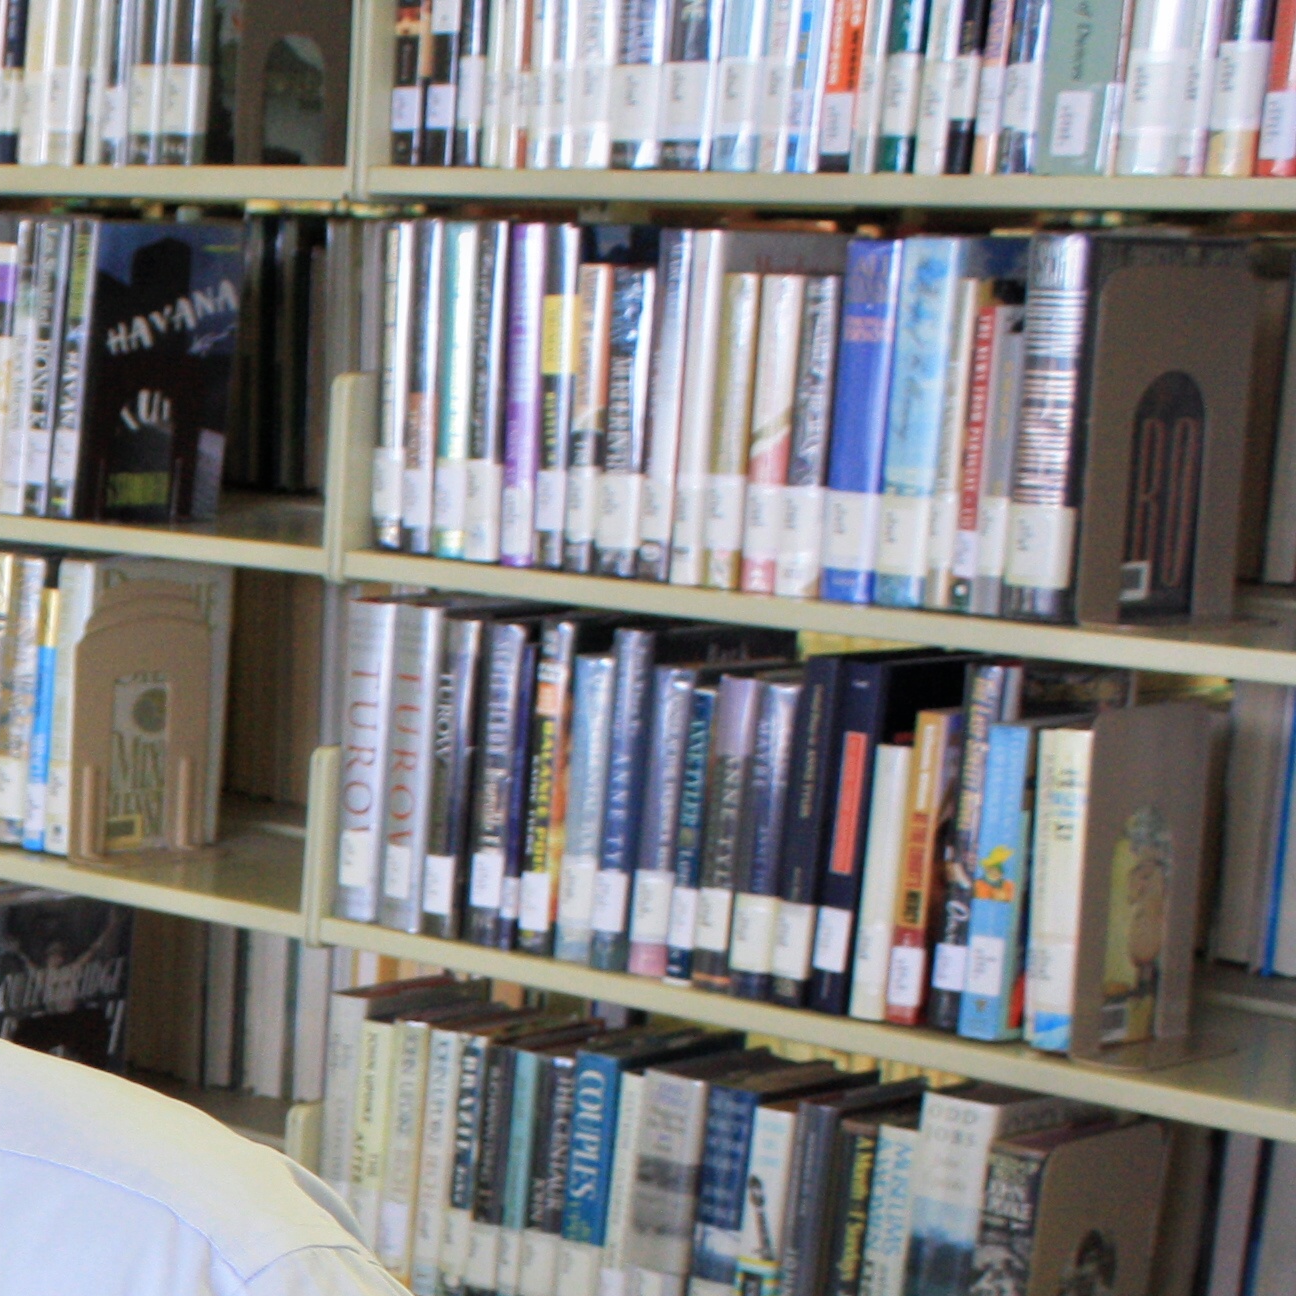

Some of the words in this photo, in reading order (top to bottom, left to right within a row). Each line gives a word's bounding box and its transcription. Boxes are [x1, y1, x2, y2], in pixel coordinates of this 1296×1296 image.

[107, 279, 240, 355] HAVANA
[343, 663, 382, 832] TURO
[435, 671, 453, 759] TUROW
[607, 753, 629, 822] ANNE
[568, 1068, 606, 1200] COUPLES
